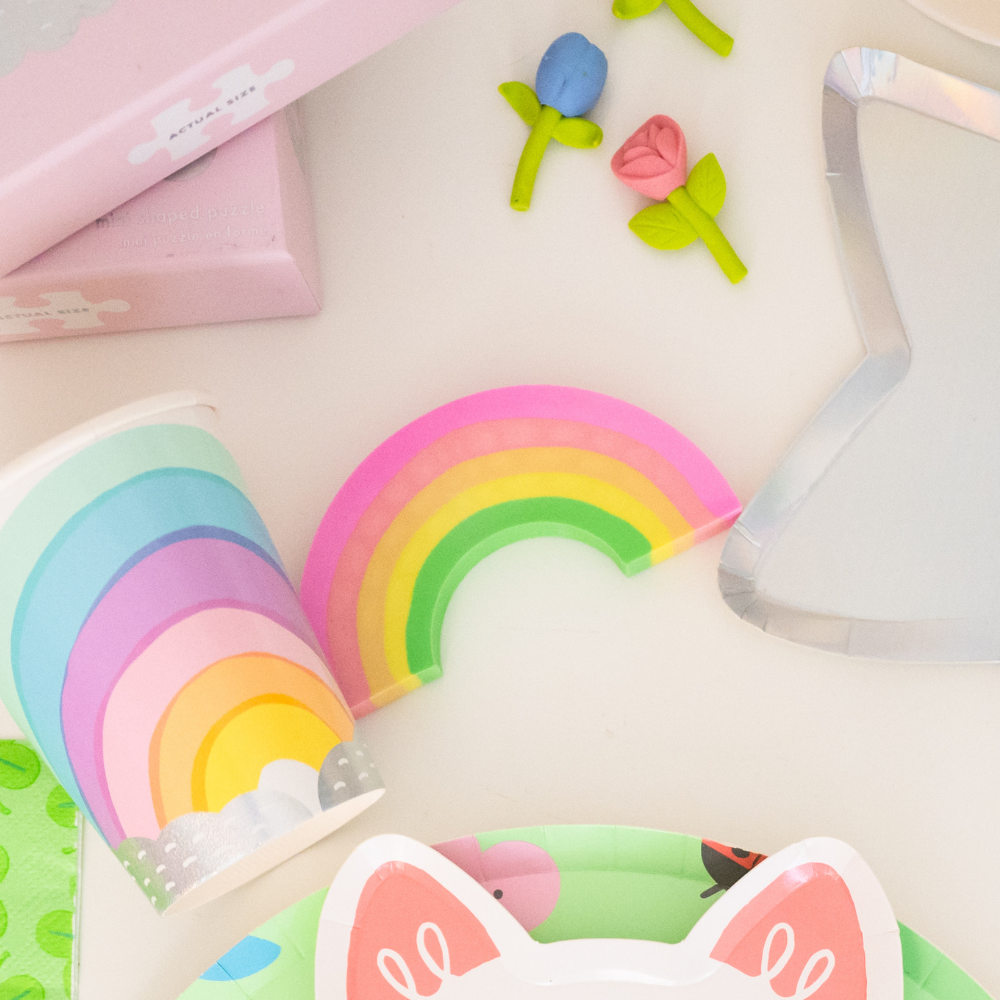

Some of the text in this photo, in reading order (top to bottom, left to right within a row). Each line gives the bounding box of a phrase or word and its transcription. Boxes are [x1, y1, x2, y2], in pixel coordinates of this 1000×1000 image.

[168, 84, 256, 141] ACTUAL SIZE
[138, 204, 200, 226] shaped
[207, 199, 266, 222] puzzle
[153, 230, 200, 247] puzzle
[205, 230, 221, 240] en
[226, 225, 268, 238] forme
[57, 307, 90, 315] SIZE
